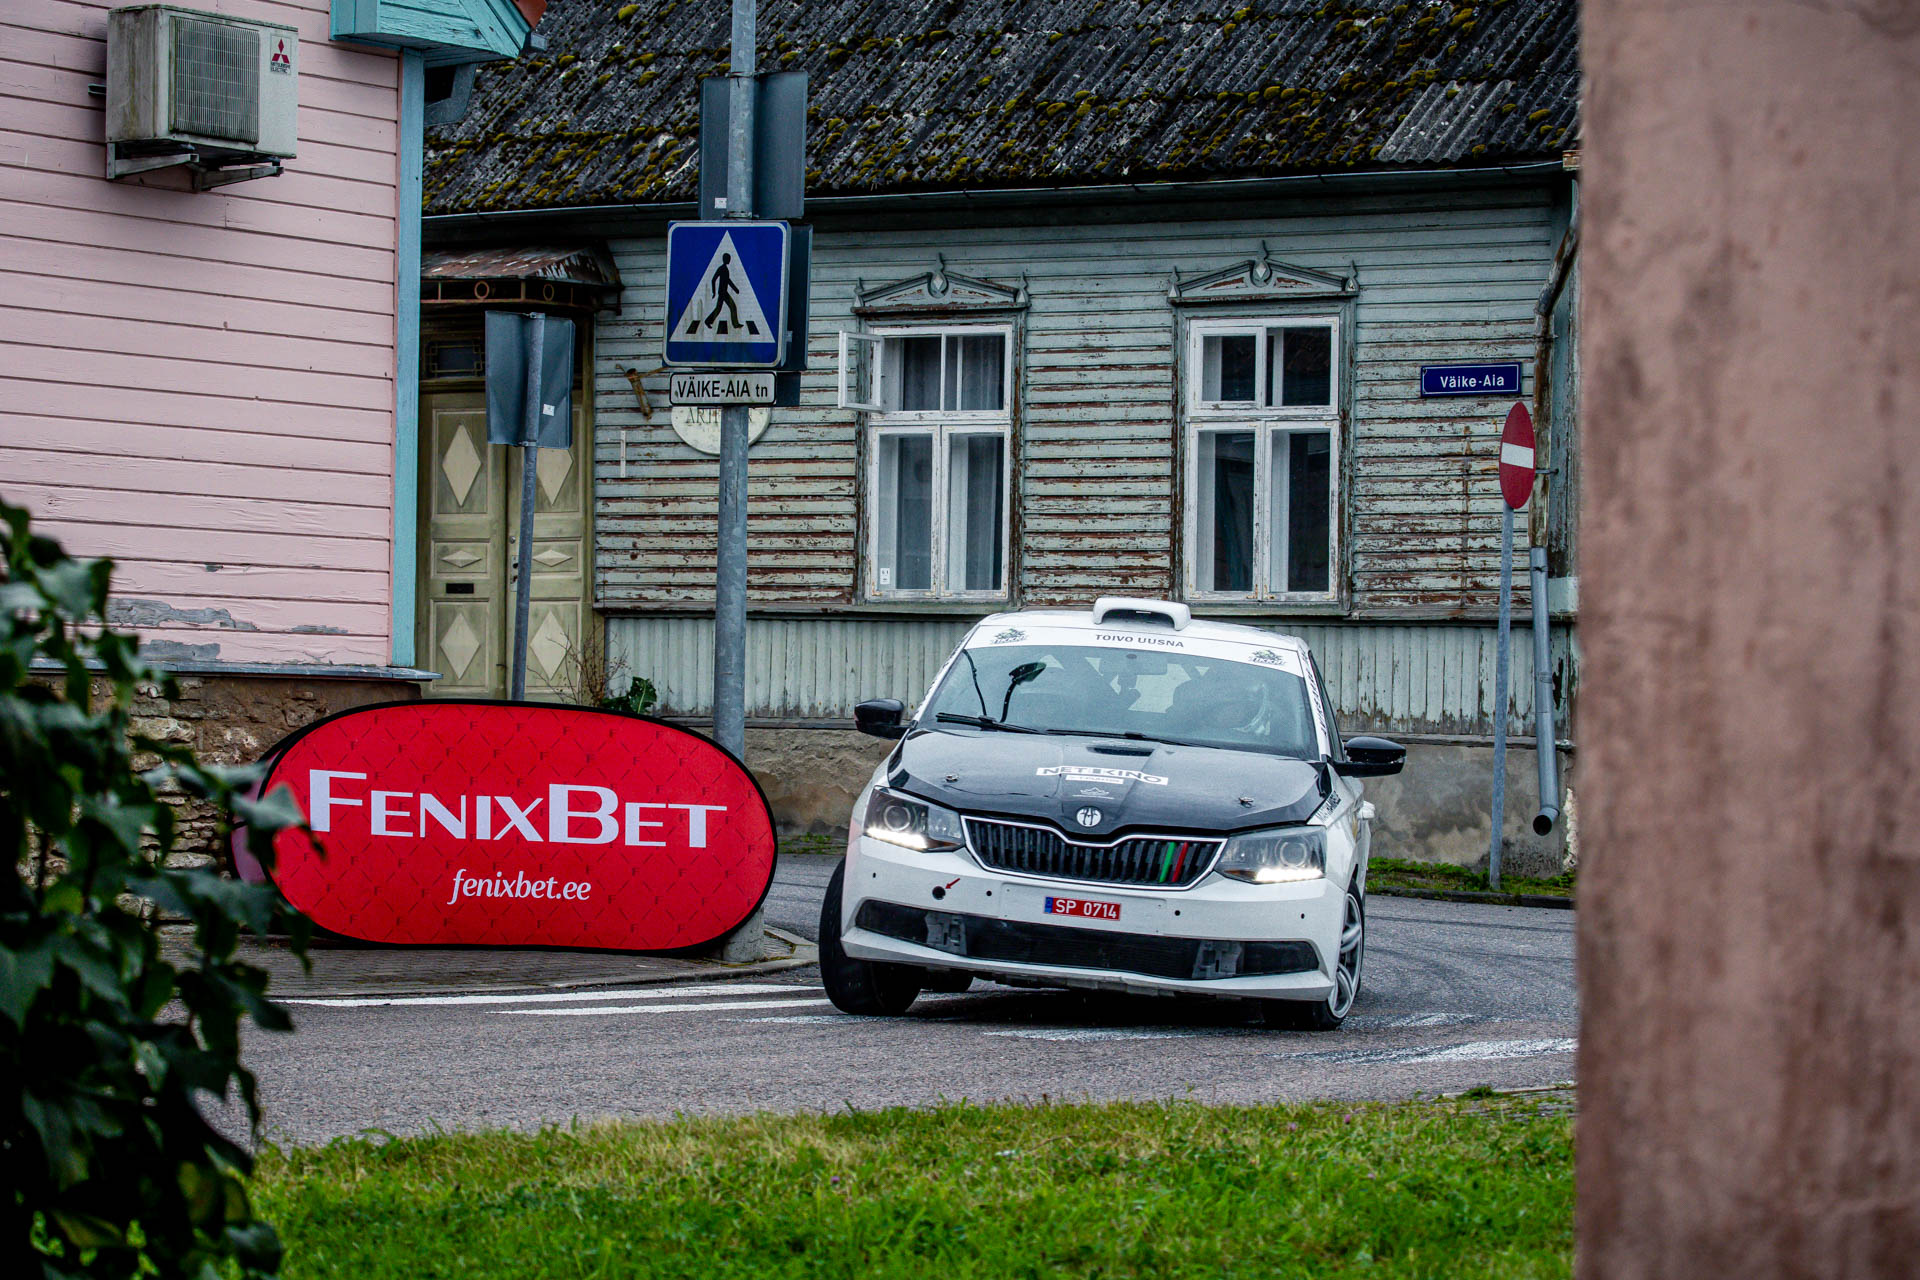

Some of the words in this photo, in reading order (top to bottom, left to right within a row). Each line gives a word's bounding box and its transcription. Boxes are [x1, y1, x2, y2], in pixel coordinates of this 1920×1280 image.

[677, 376, 750, 398] VÄIKE-AIA
[755, 384, 768, 397] tn
[1440, 374, 1504, 388] Väike-Aia
[1095, 634, 1133, 643] TOIVO
[1138, 637, 1184, 648] UUSNA
[447, 868, 592, 905] fenixbet.ee
[1056, 899, 1077, 914] SP
[1084, 902, 1117, 919] 0714
